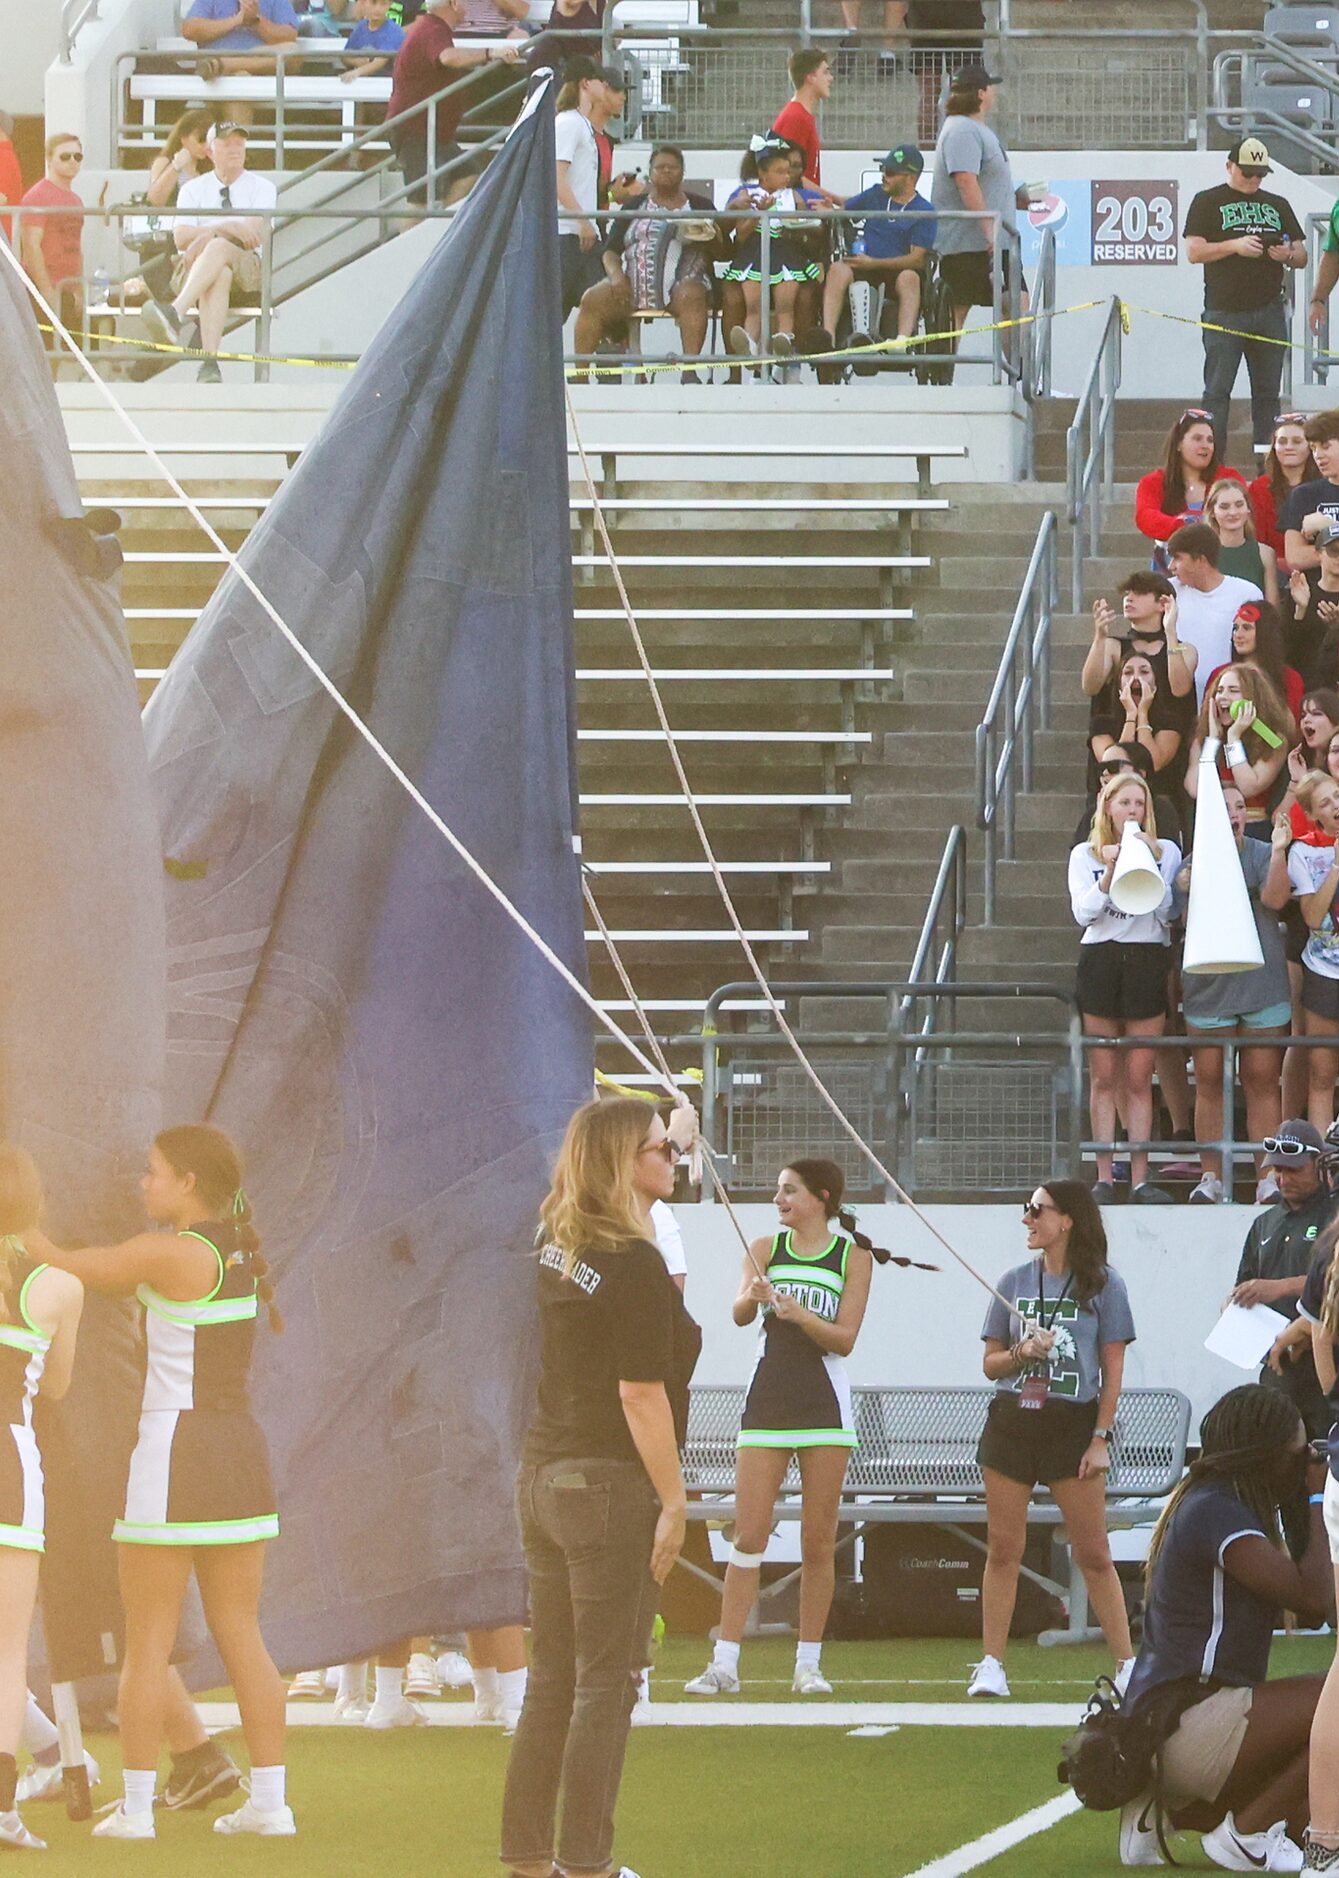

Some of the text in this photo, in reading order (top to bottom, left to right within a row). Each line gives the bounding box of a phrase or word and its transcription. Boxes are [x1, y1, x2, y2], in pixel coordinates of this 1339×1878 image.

[1250, 151, 1263, 162] W
[1095, 196, 1174, 241] 203
[1219, 201, 1282, 231] EHS
[1094, 244, 1177, 263] RESERVED
